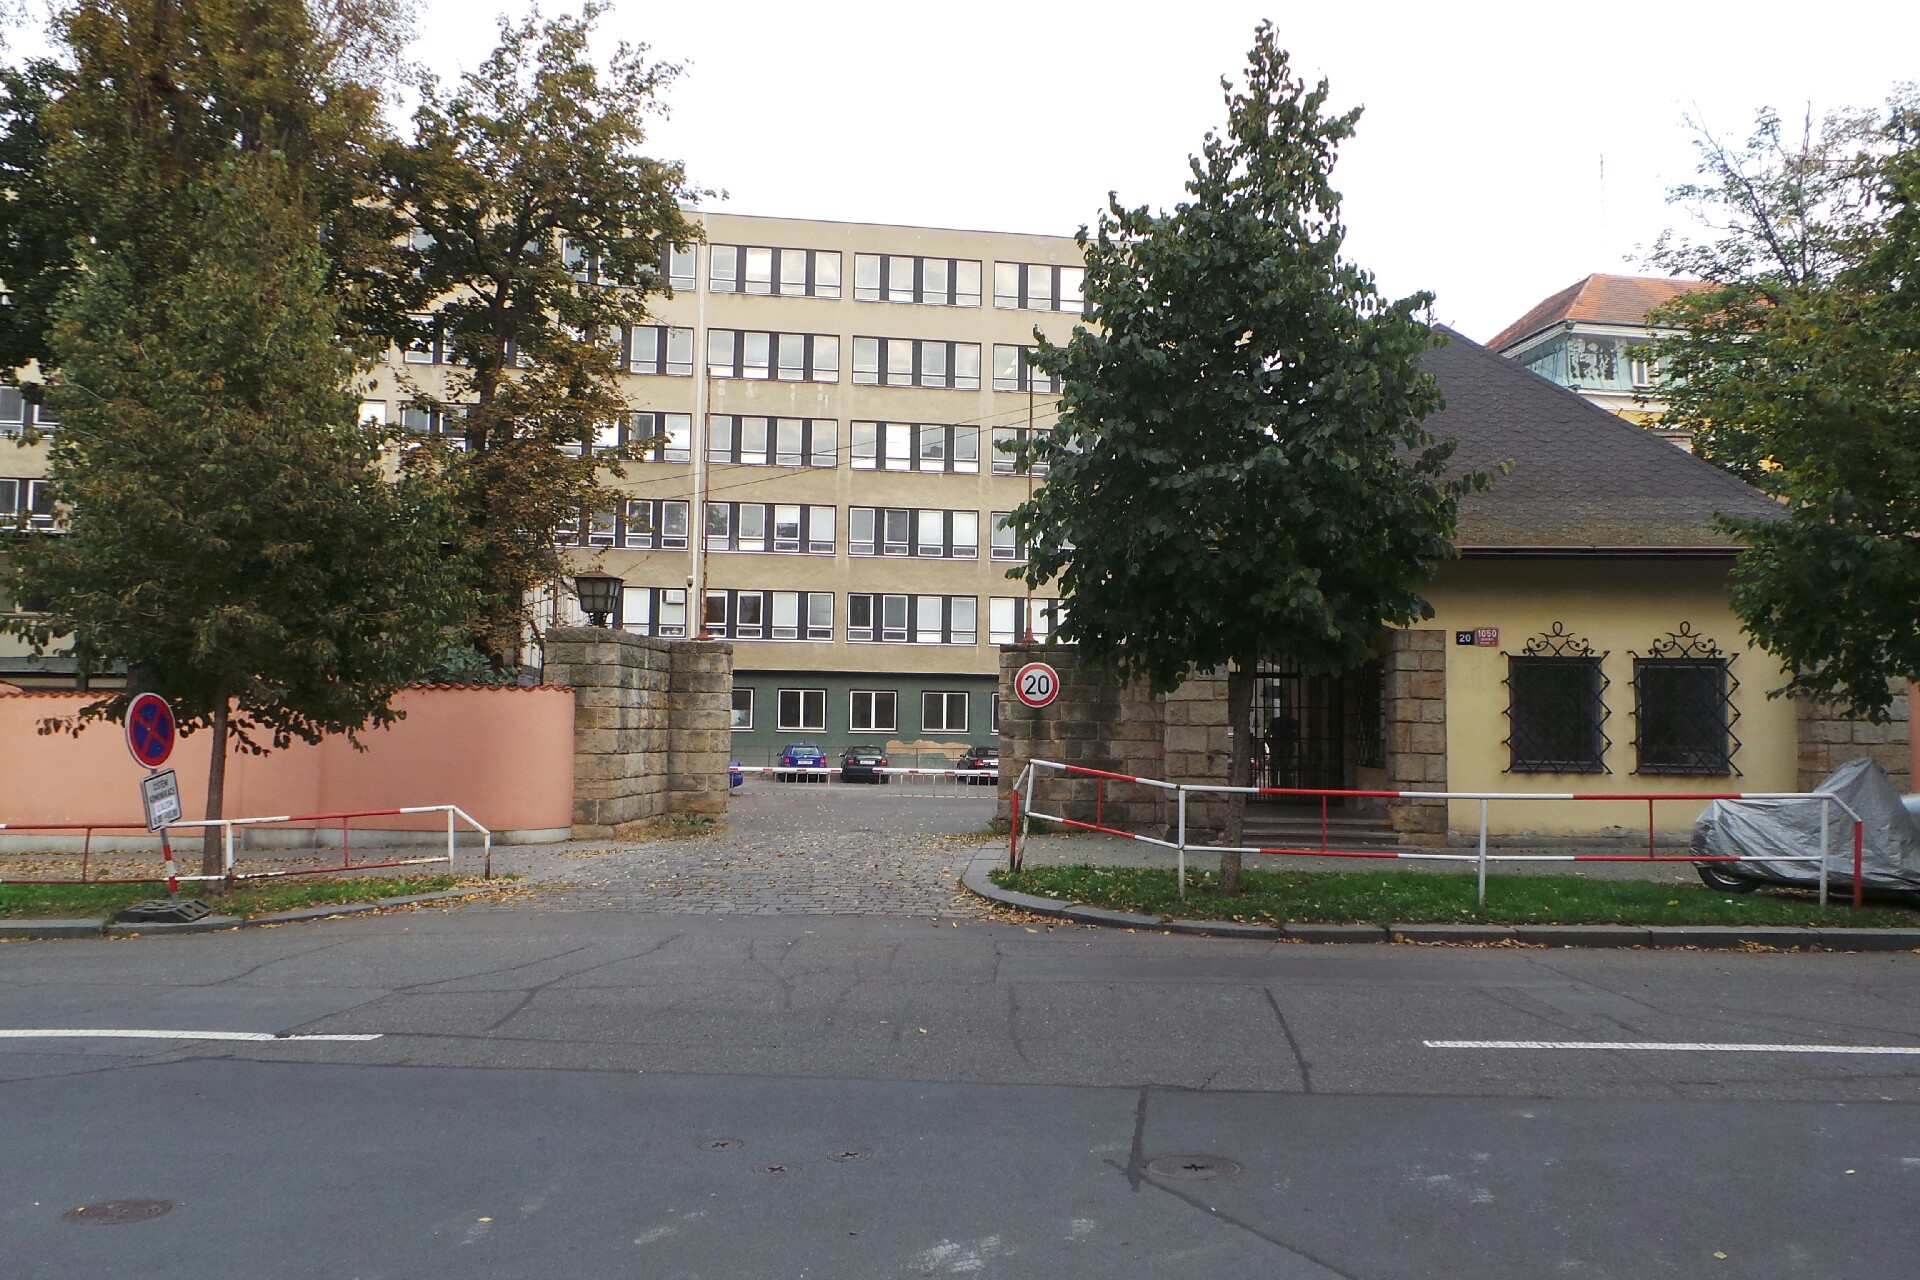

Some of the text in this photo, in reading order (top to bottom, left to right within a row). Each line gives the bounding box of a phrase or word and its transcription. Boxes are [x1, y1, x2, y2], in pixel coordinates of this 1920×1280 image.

[1478, 629, 1497, 638] 1050
[1459, 634, 1471, 643] 20
[1024, 674, 1050, 695] 20
